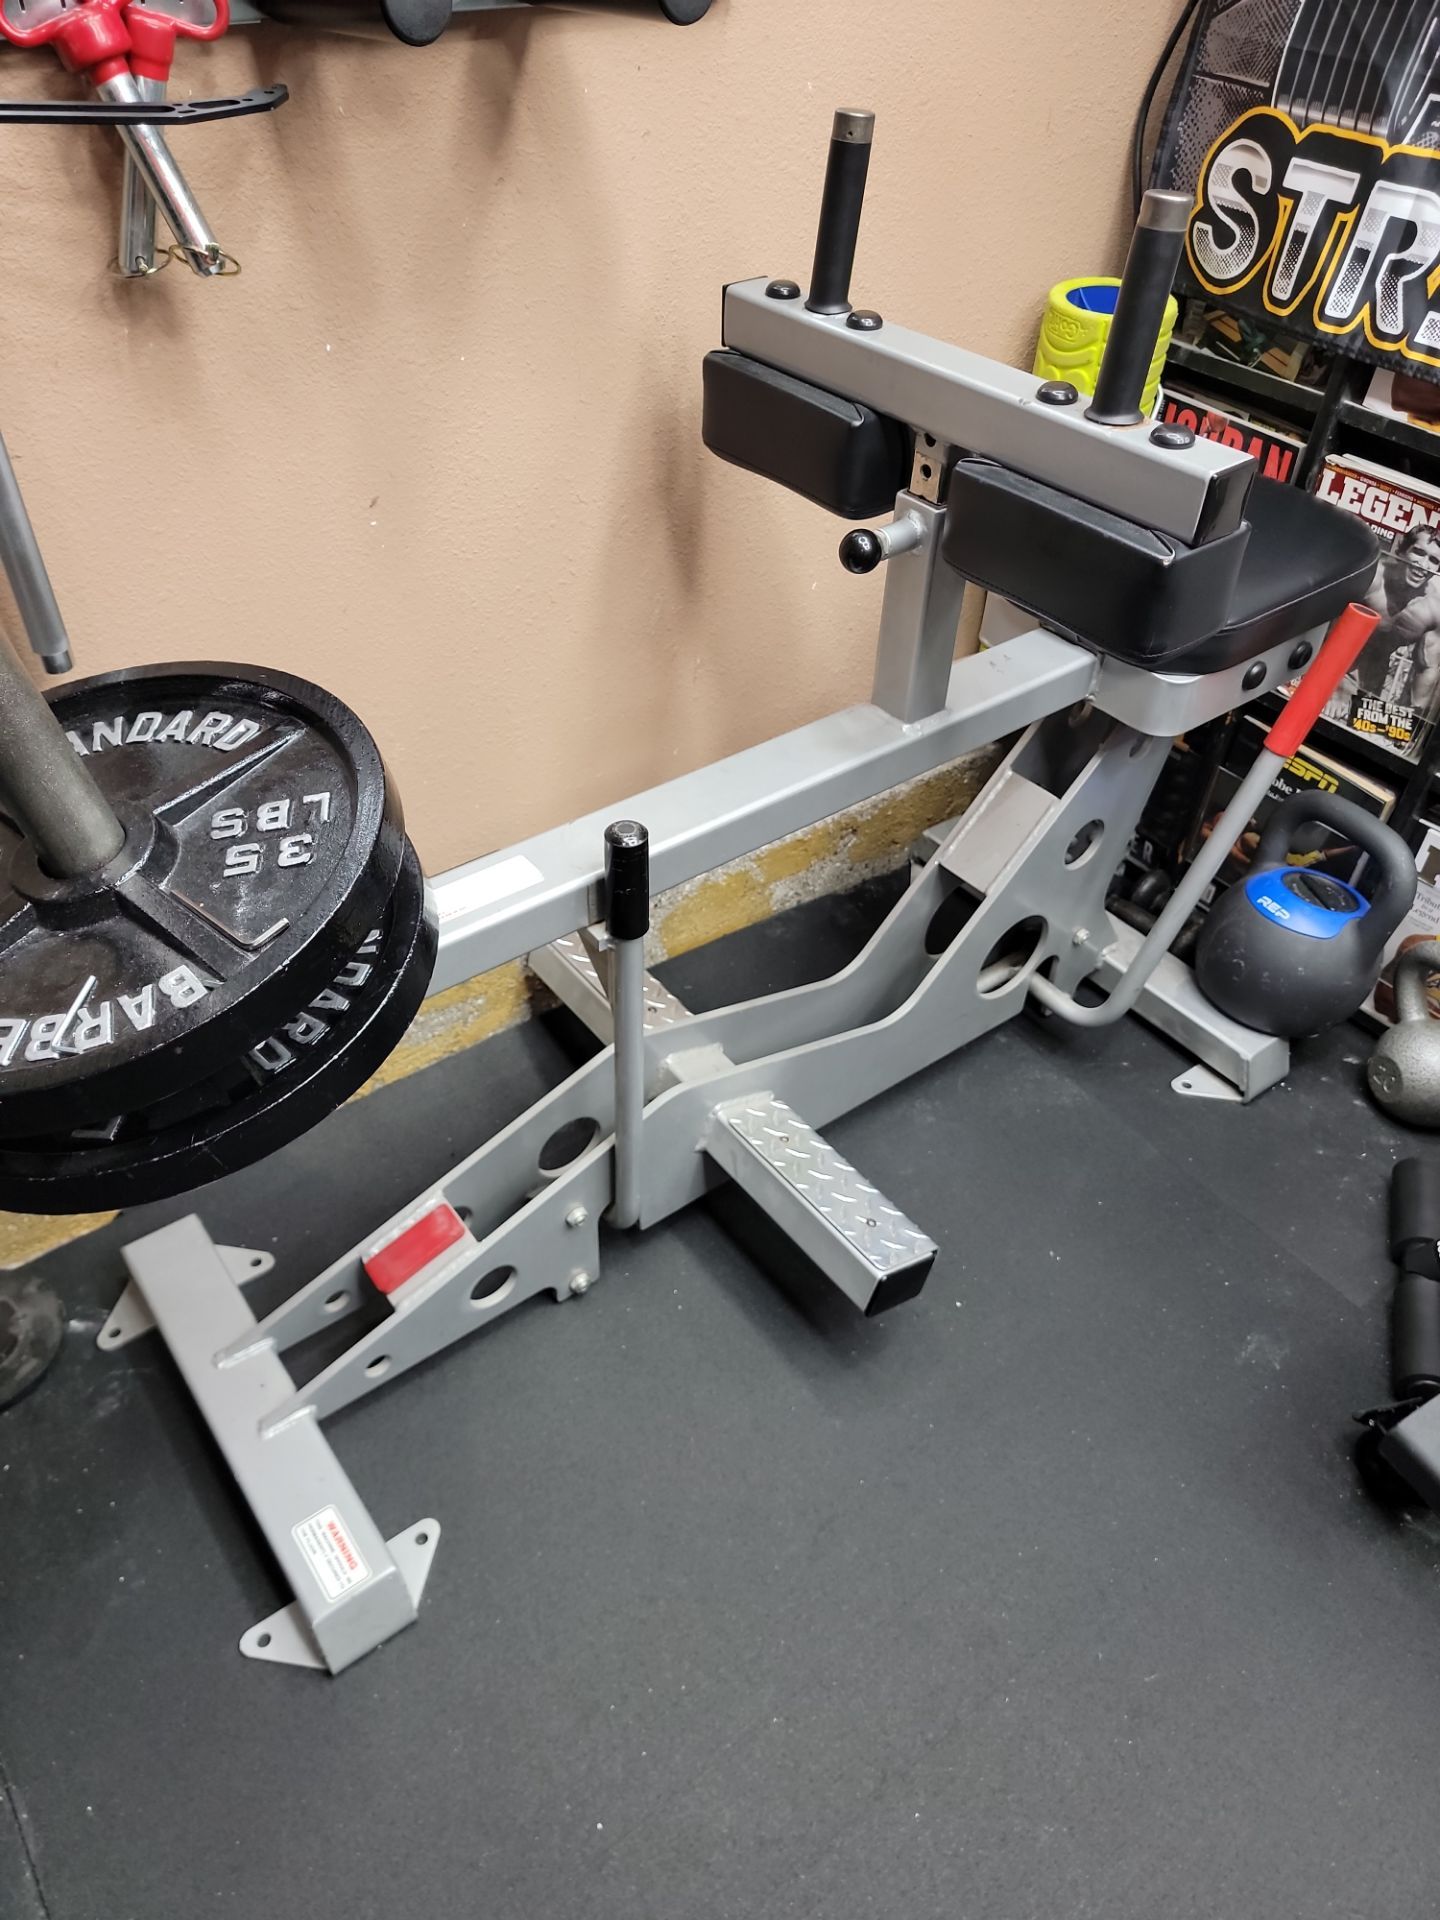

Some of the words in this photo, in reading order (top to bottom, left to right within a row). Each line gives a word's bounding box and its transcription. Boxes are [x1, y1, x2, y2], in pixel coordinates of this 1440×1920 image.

[1192, 138, 1440, 347] STR
[1366, 522, 1395, 540] DING
[1357, 707, 1388, 725] FROM
[1390, 714, 1413, 730] THE
[1361, 697, 1383, 712] THE
[1385, 701, 1415, 719] BEST
[1272, 777, 1294, 796] obe
[210, 792, 331, 840] LBS
[223, 833, 316, 878] 35
[1256, 896, 1291, 919] REP
